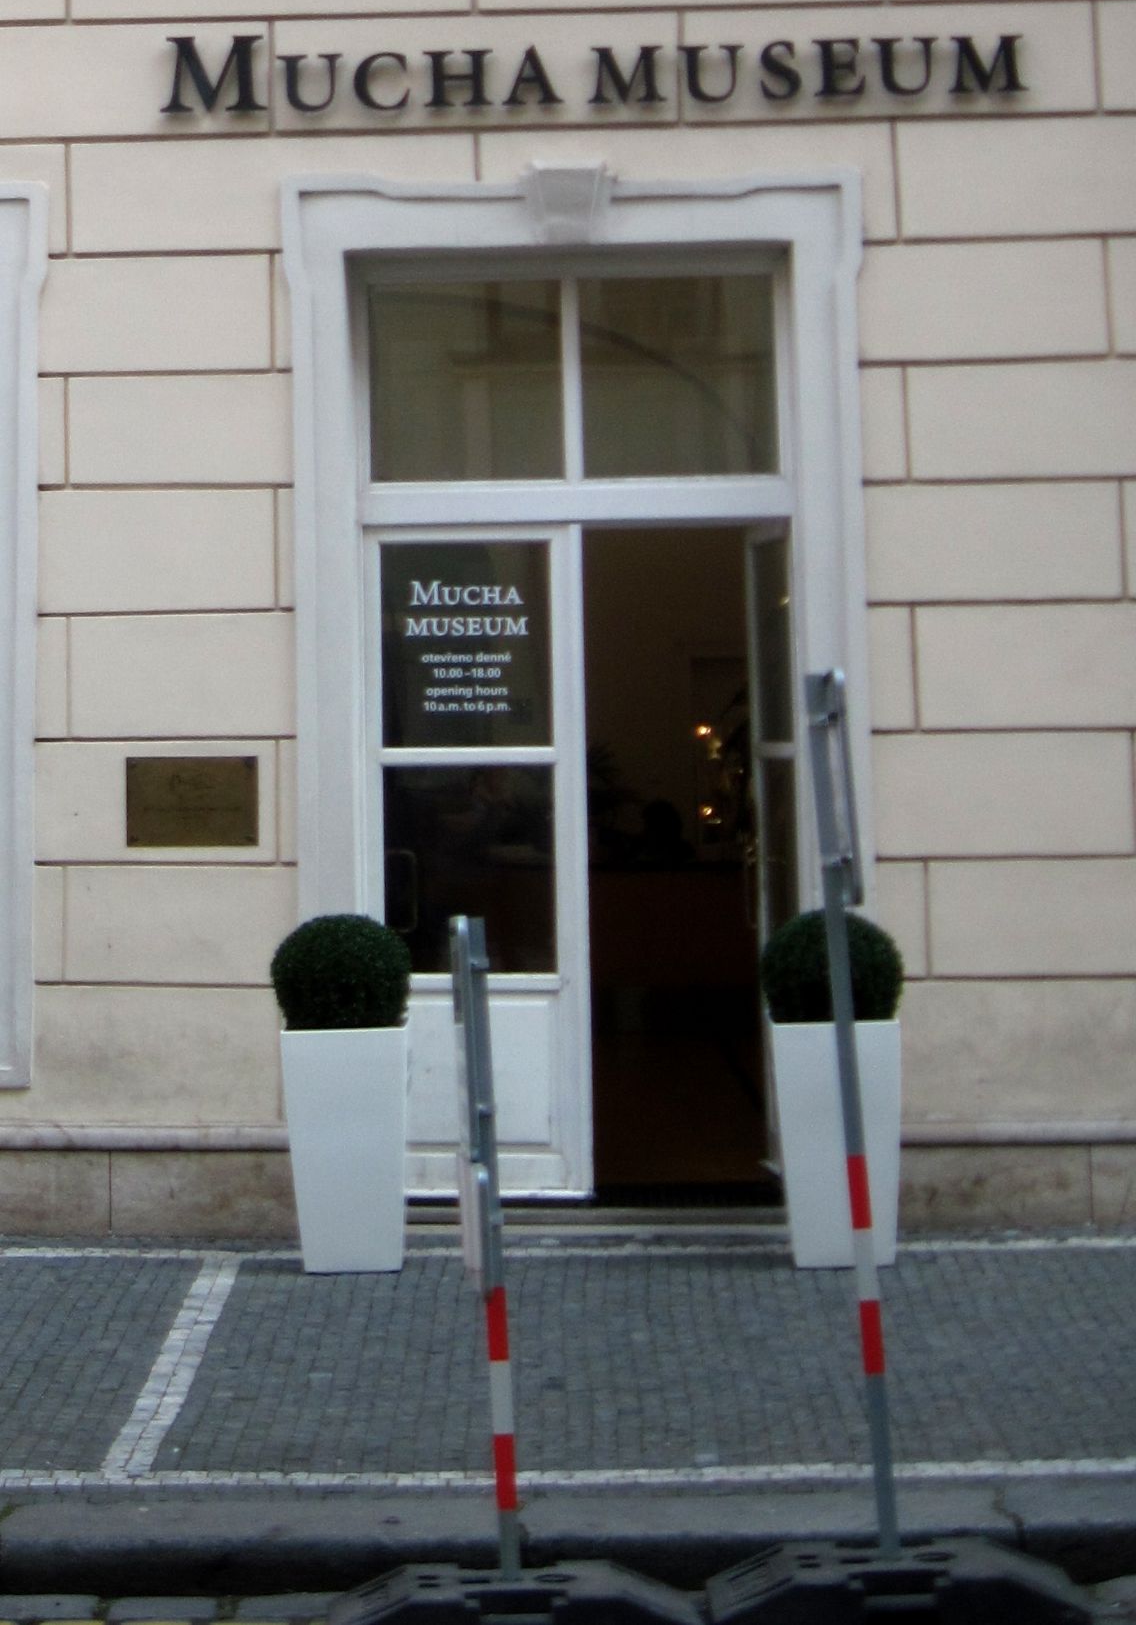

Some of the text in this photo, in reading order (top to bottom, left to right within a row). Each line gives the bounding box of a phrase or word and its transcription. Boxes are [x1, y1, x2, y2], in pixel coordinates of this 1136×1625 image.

[160, 33, 1029, 113] MUCHA MUSEUM
[410, 580, 524, 606] MUCHA
[405, 616, 529, 637] MUSEUM
[425, 686, 508, 698] opening hours
